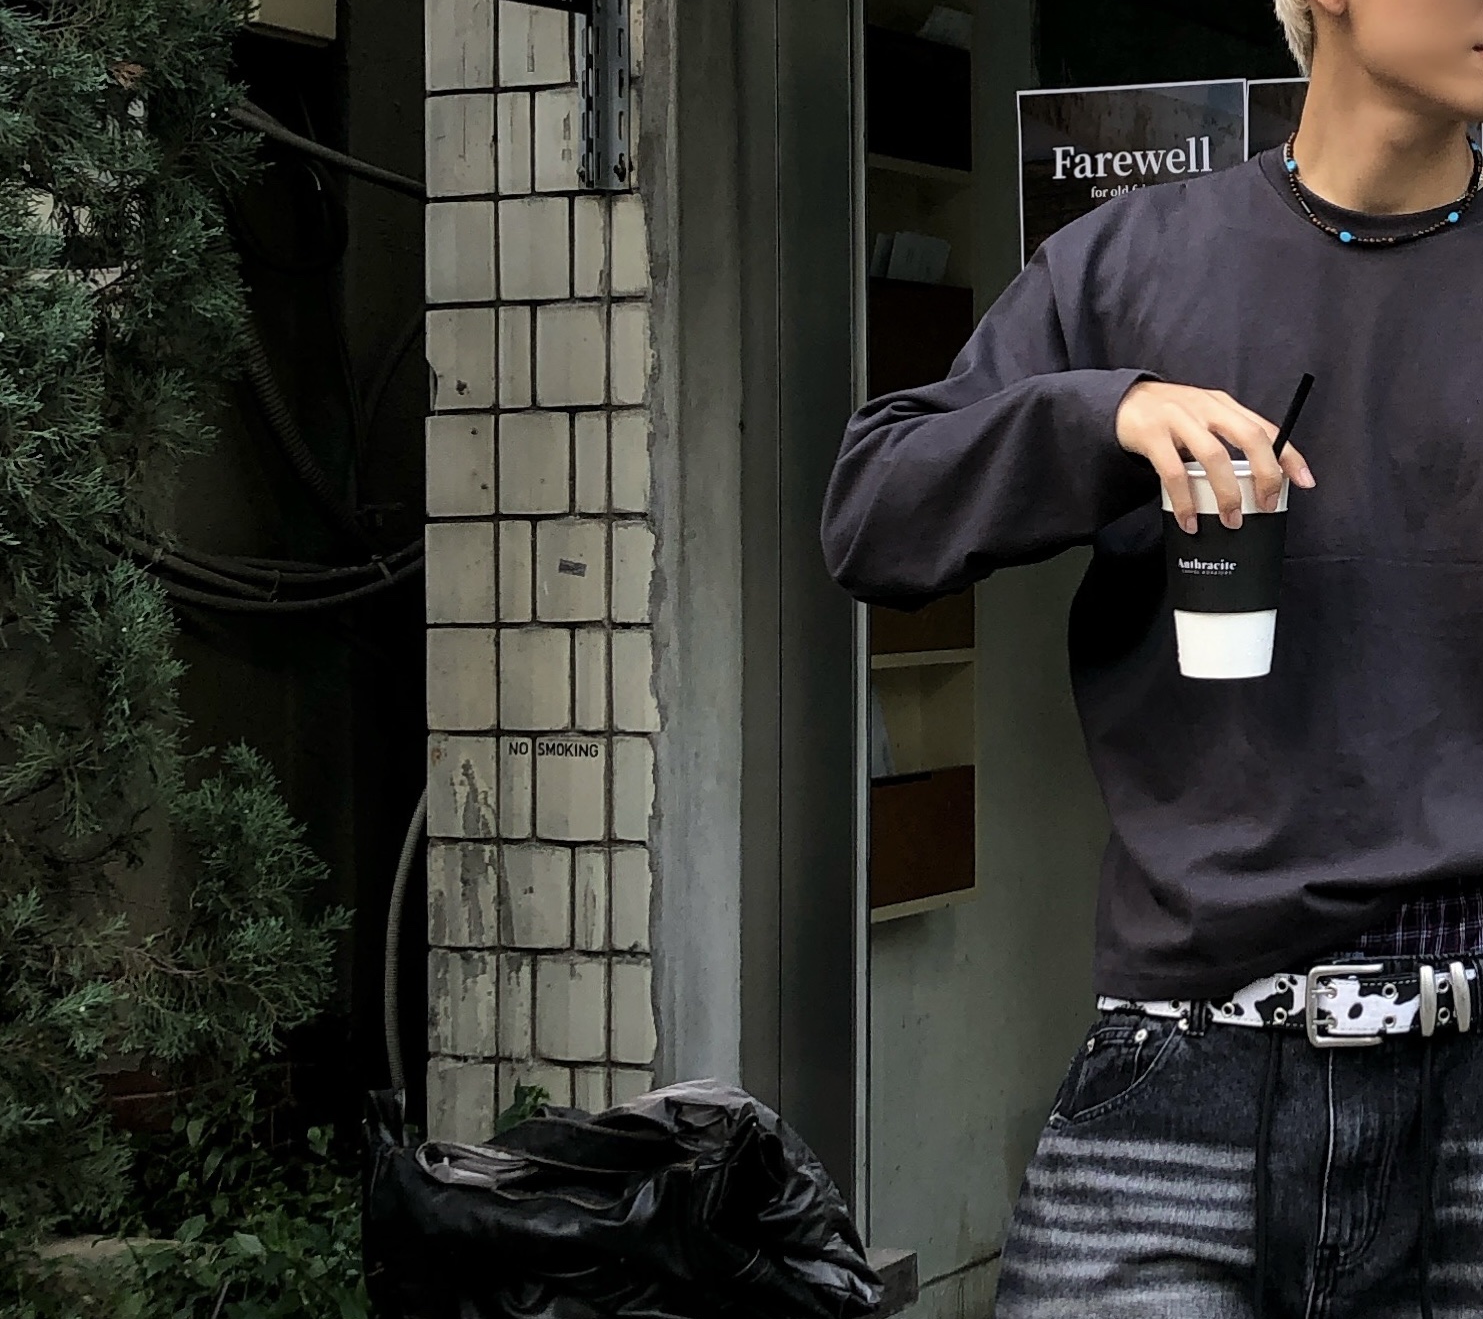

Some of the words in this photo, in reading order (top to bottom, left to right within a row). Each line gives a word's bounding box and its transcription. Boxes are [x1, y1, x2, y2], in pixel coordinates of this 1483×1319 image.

[1052, 136, 1213, 180] Farewell
[1091, 186, 1109, 199] for
[508, 742, 529, 756] NO
[537, 742, 599, 758] SMOKING
